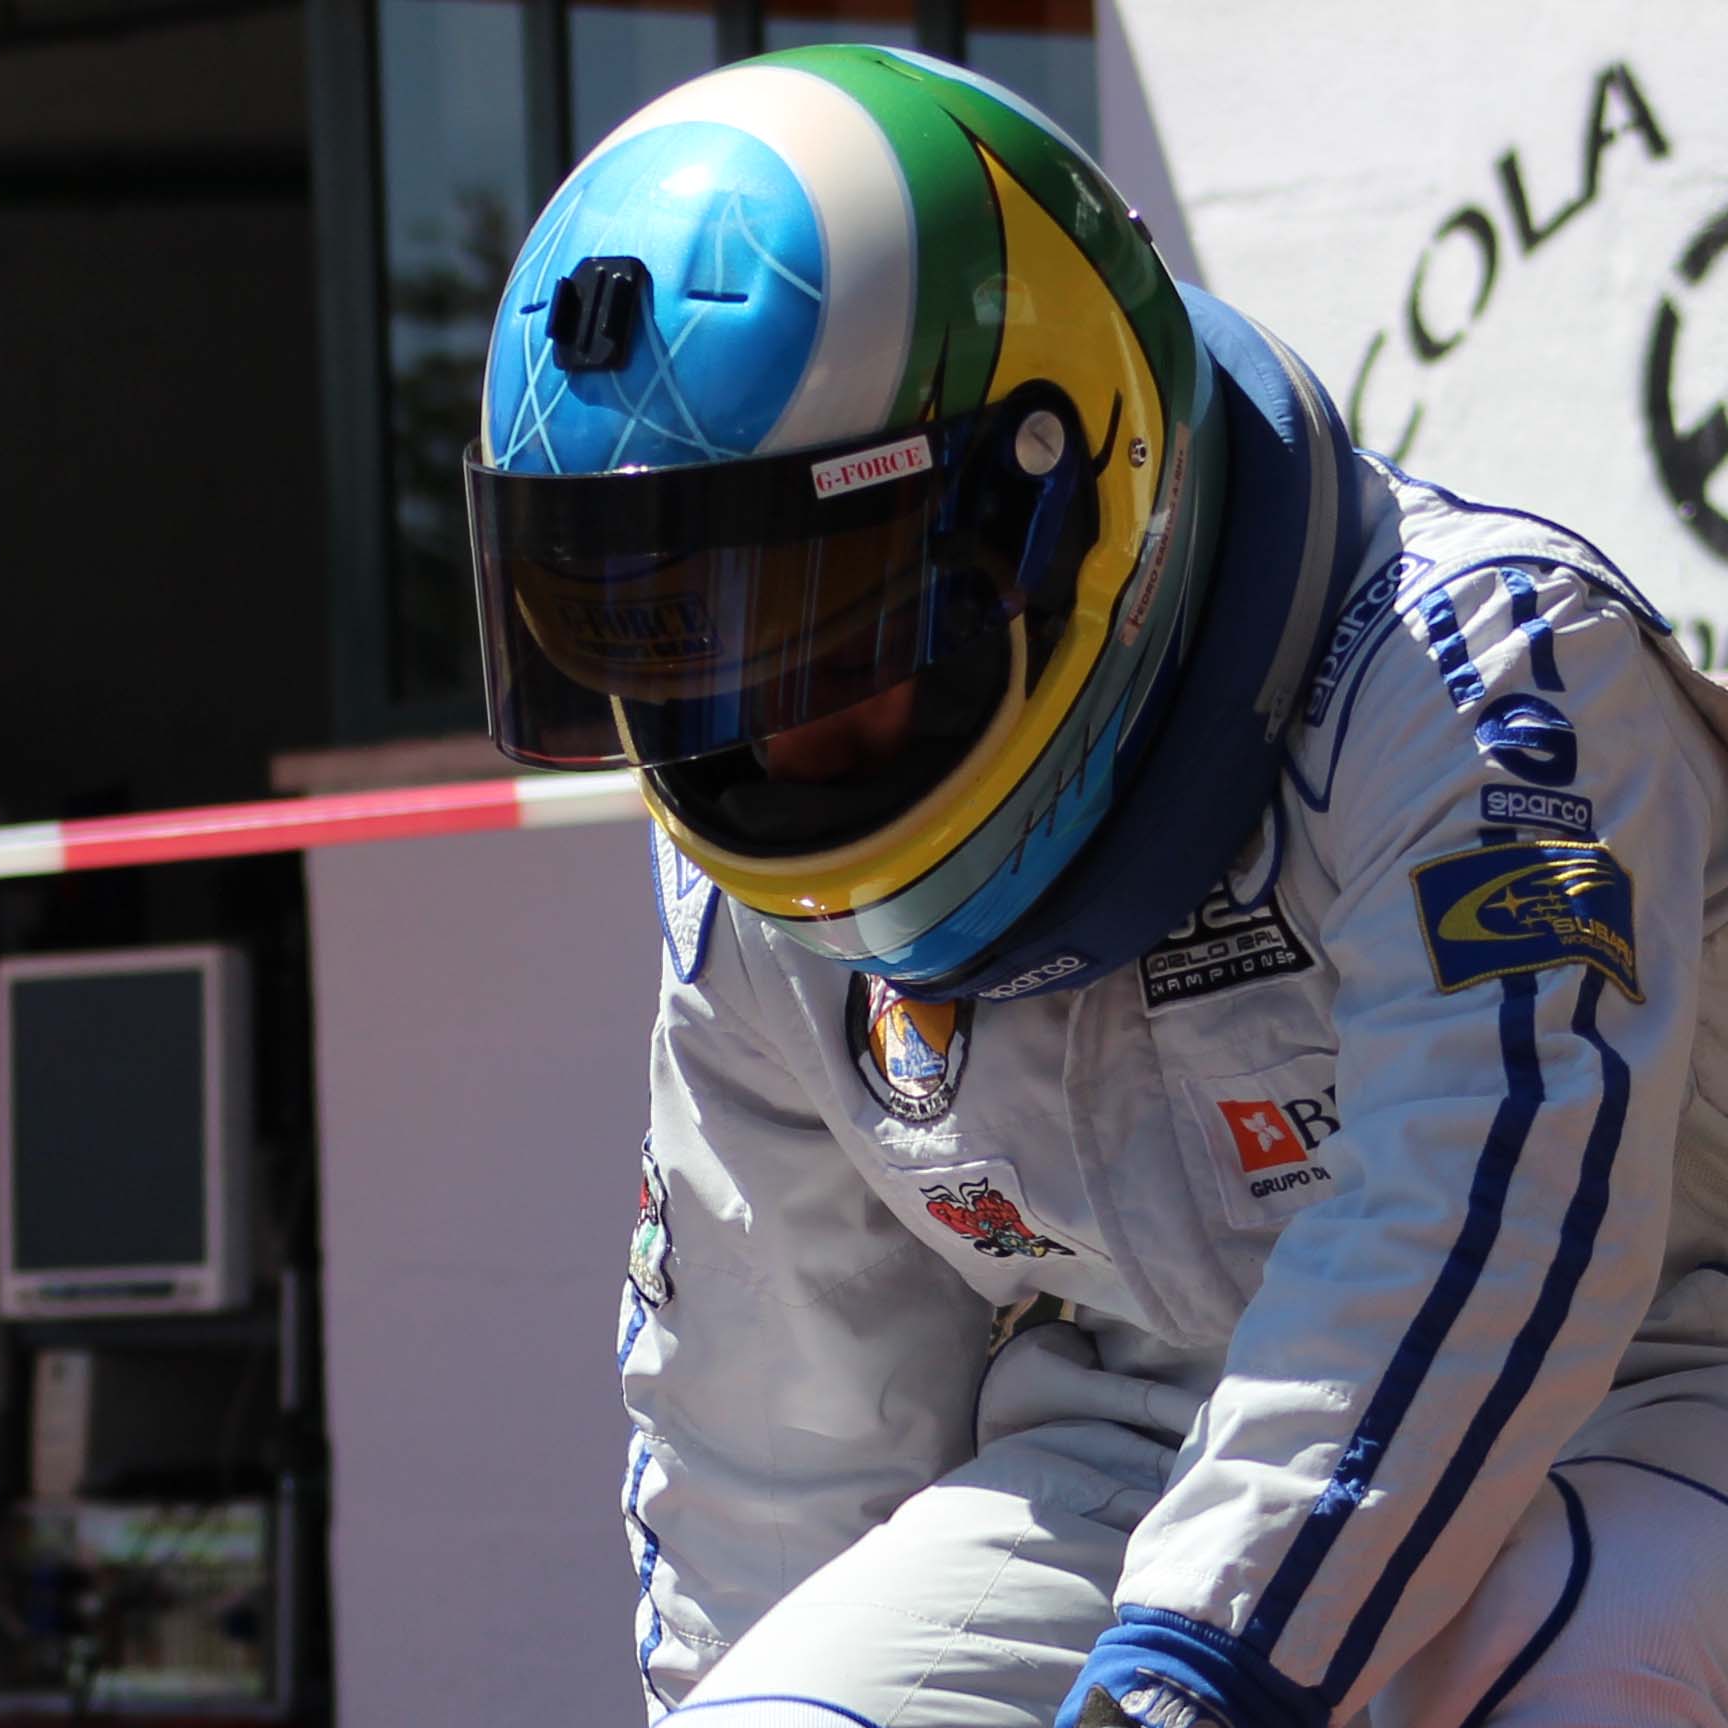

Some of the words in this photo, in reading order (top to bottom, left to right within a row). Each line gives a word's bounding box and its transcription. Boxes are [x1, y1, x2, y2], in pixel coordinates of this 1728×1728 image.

[816, 444, 924, 494] G-FORCE
[1486, 789, 1590, 828] sparco
[978, 955, 1081, 998] sparco
[1250, 1170, 1310, 1198] GRUPO
